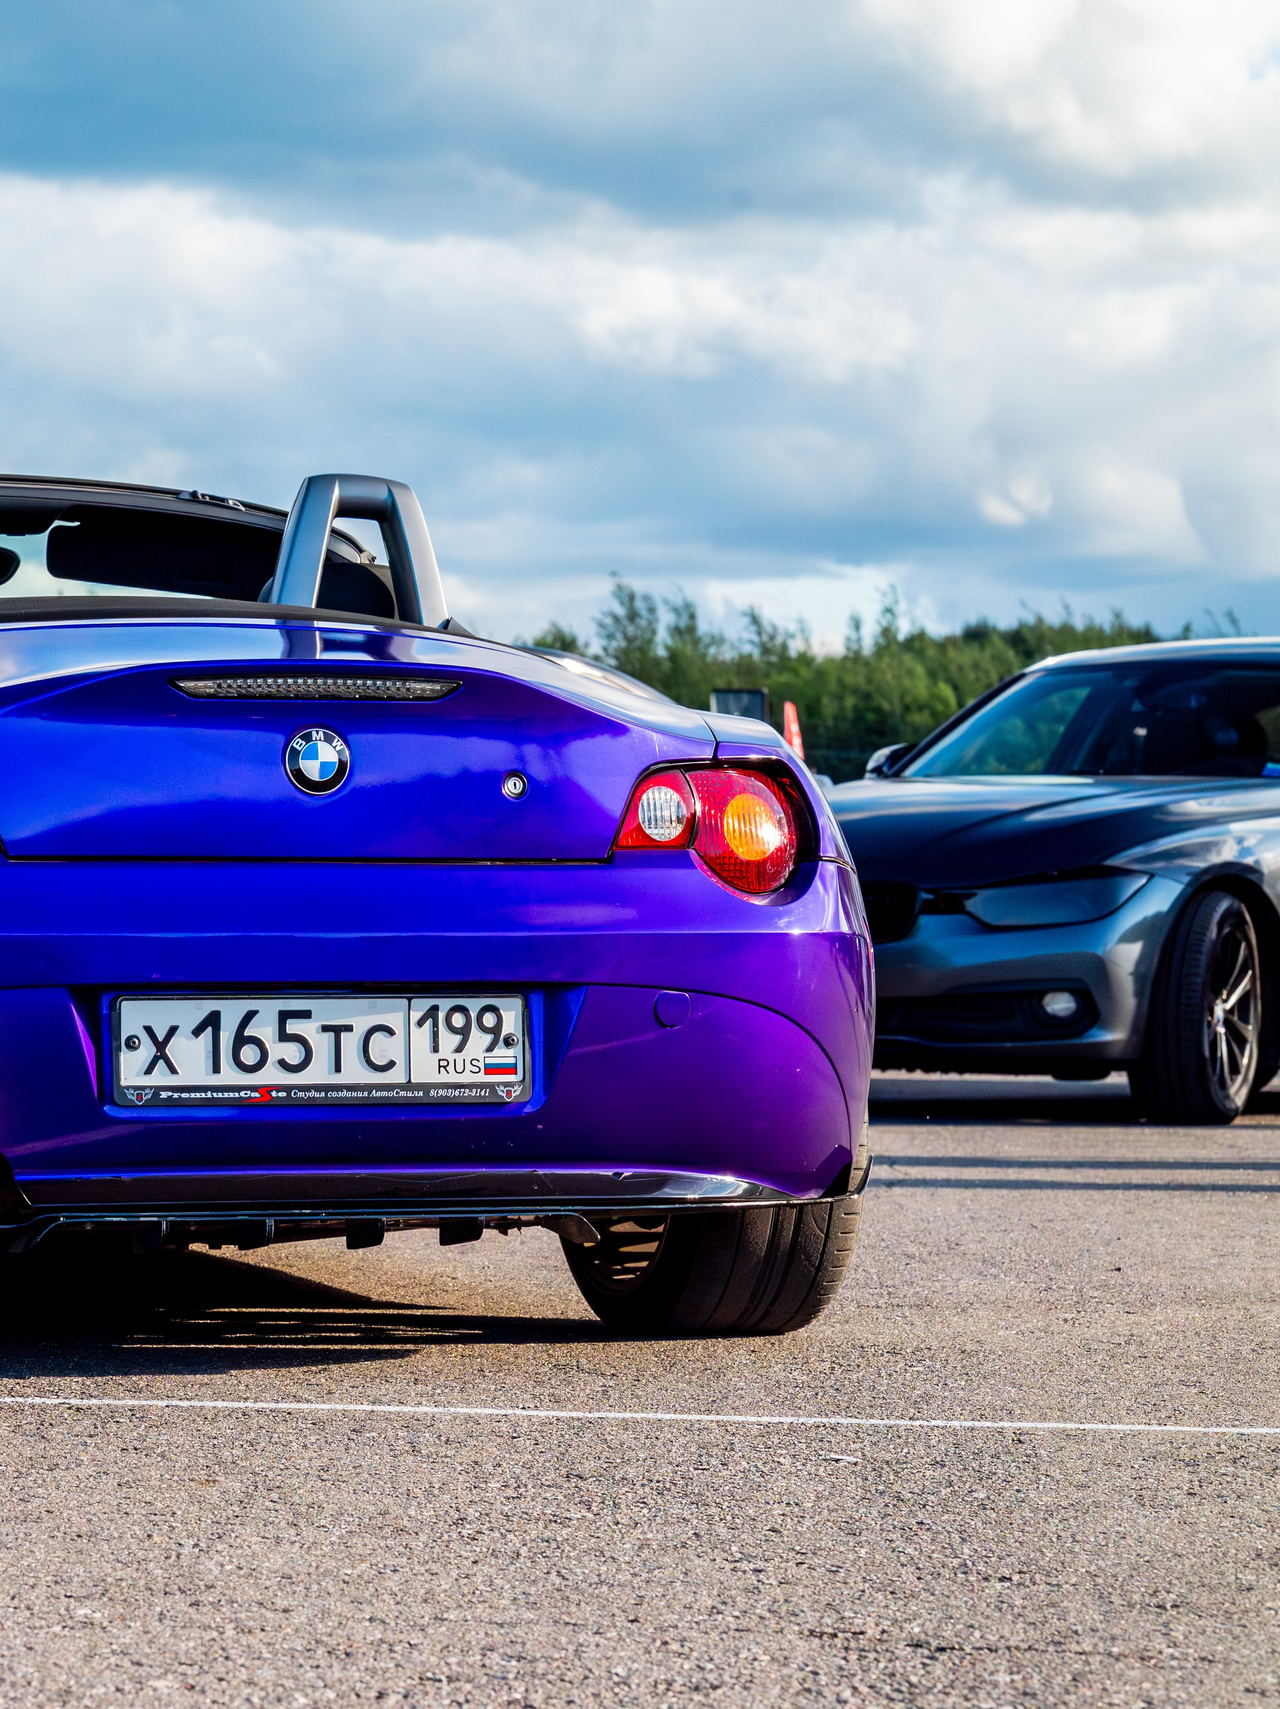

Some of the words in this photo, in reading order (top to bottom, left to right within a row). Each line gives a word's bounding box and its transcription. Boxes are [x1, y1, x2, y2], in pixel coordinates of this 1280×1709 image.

[292, 730, 344, 751] BMW
[417, 1004, 503, 1054] 199
[437, 1058, 482, 1075] RUS
[291, 1089, 325, 1100] Студия
[327, 1089, 368, 1098] создания
[370, 1088, 423, 1098] АвтоСтиля
[429, 1088, 490, 1098] 8(903)672-3141
